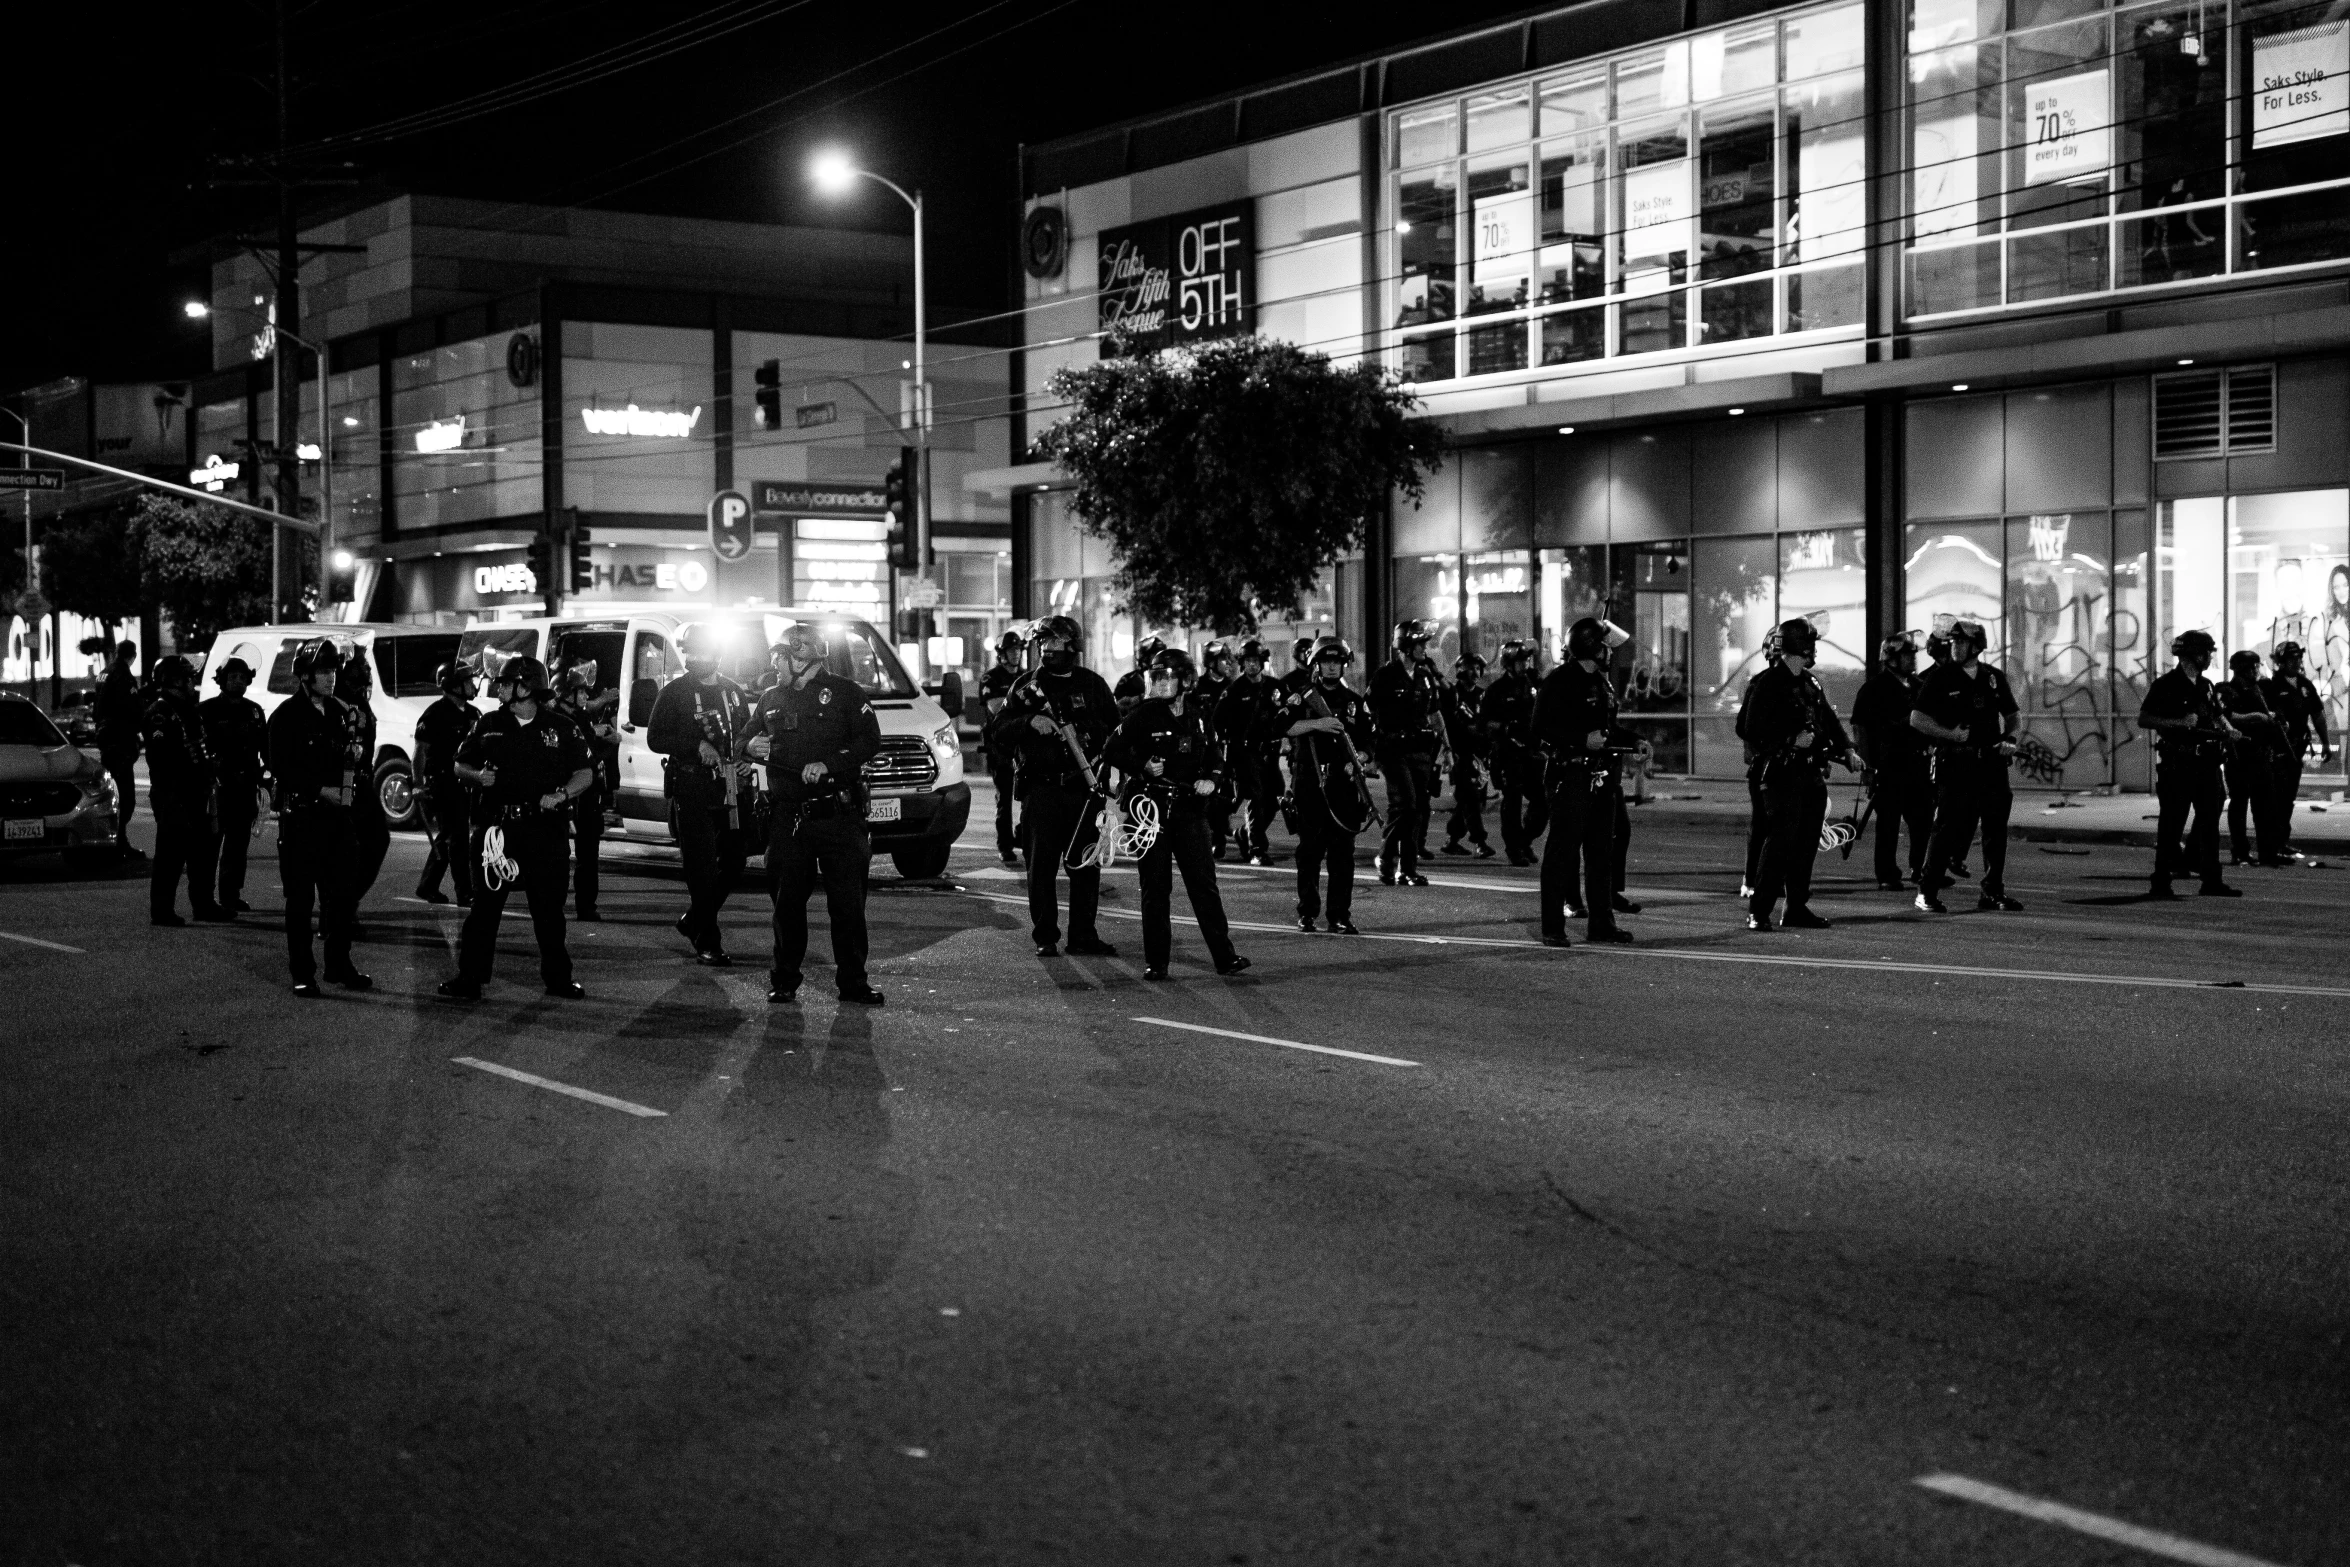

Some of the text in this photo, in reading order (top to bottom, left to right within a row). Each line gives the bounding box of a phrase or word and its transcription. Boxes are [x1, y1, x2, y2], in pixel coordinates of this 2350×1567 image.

[2264, 75, 2290, 91] Saks
[2035, 97, 2058, 111] up to
[2264, 90, 2321, 110] For Less.
[2035, 145, 2078, 160] every day
[1700, 181, 1741, 203] HOES
[1180, 216, 1240, 277] OFF
[1100, 239, 1145, 291] Saks
[1180, 269, 1241, 330] 5TH
[723, 498, 746, 527] P
[592, 563, 677, 589] HASE
[870, 807, 898, 818] 565116
